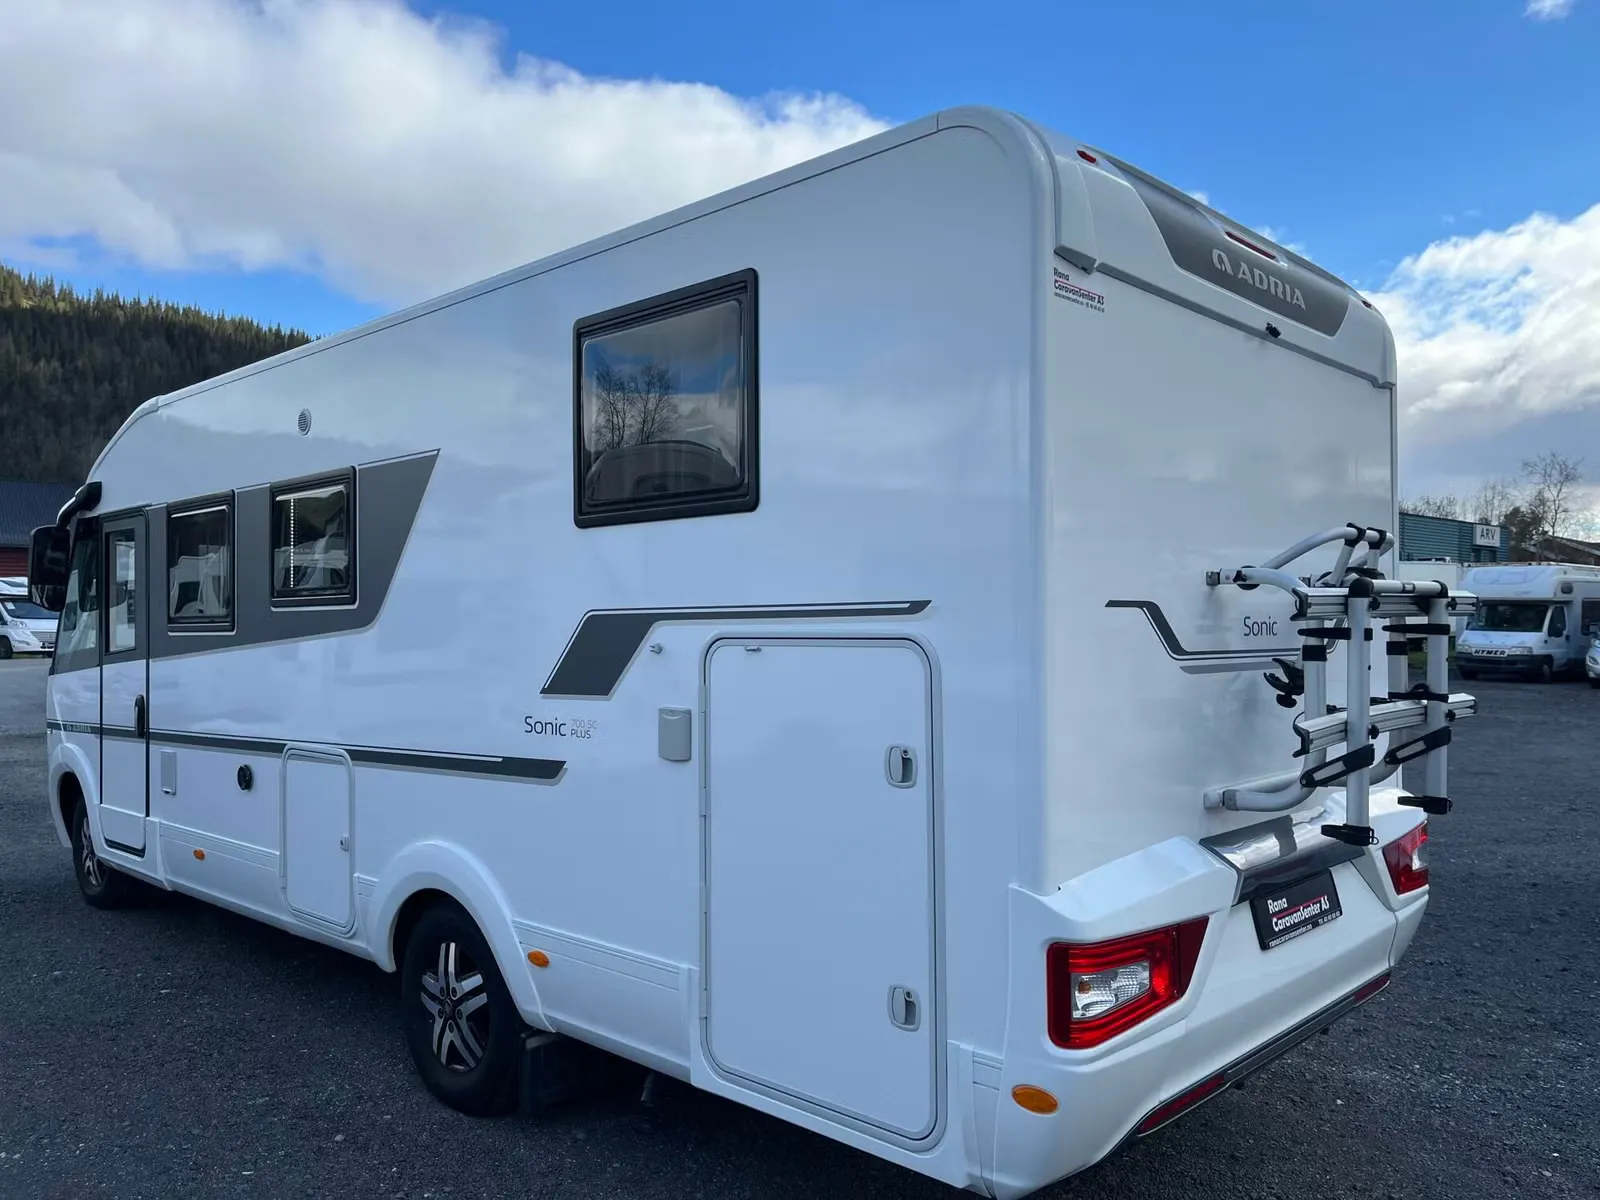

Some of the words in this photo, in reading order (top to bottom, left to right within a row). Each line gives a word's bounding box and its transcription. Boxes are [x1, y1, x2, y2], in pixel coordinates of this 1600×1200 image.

[1053, 267, 1070, 281] Rana
[1238, 261, 1306, 310] ADRIA
[1480, 527, 1496, 541] ARV
[1243, 615, 1278, 637] Sonic
[1473, 649, 1506, 657] HYMER
[524, 715, 567, 737] Sonic
[571, 719, 586, 729] 700
[587, 720, 597, 729] SC
[570, 728, 591, 739] PLUS
[1267, 897, 1288, 914] Rana
[1272, 902, 1321, 932] CaravanSenter
[1320, 895, 1330, 912] AS
